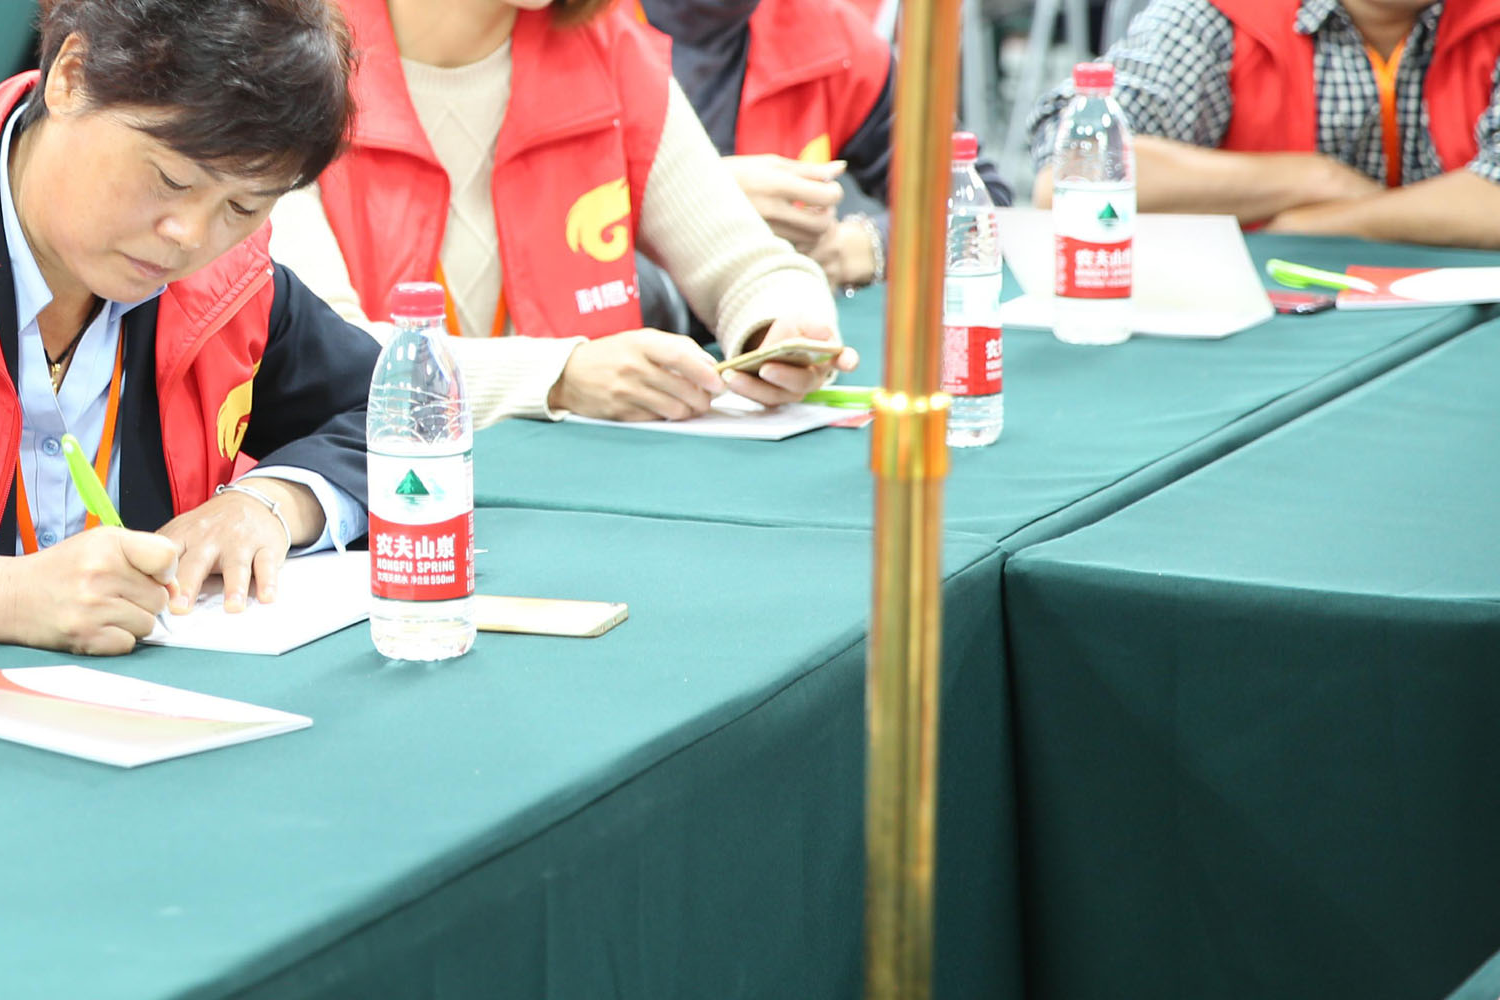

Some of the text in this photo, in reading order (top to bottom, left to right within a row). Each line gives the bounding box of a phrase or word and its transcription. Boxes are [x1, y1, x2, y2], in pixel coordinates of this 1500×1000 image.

[376, 533, 455, 560] 农夫山泉
[377, 559, 455, 574] NONGFU SPRING
